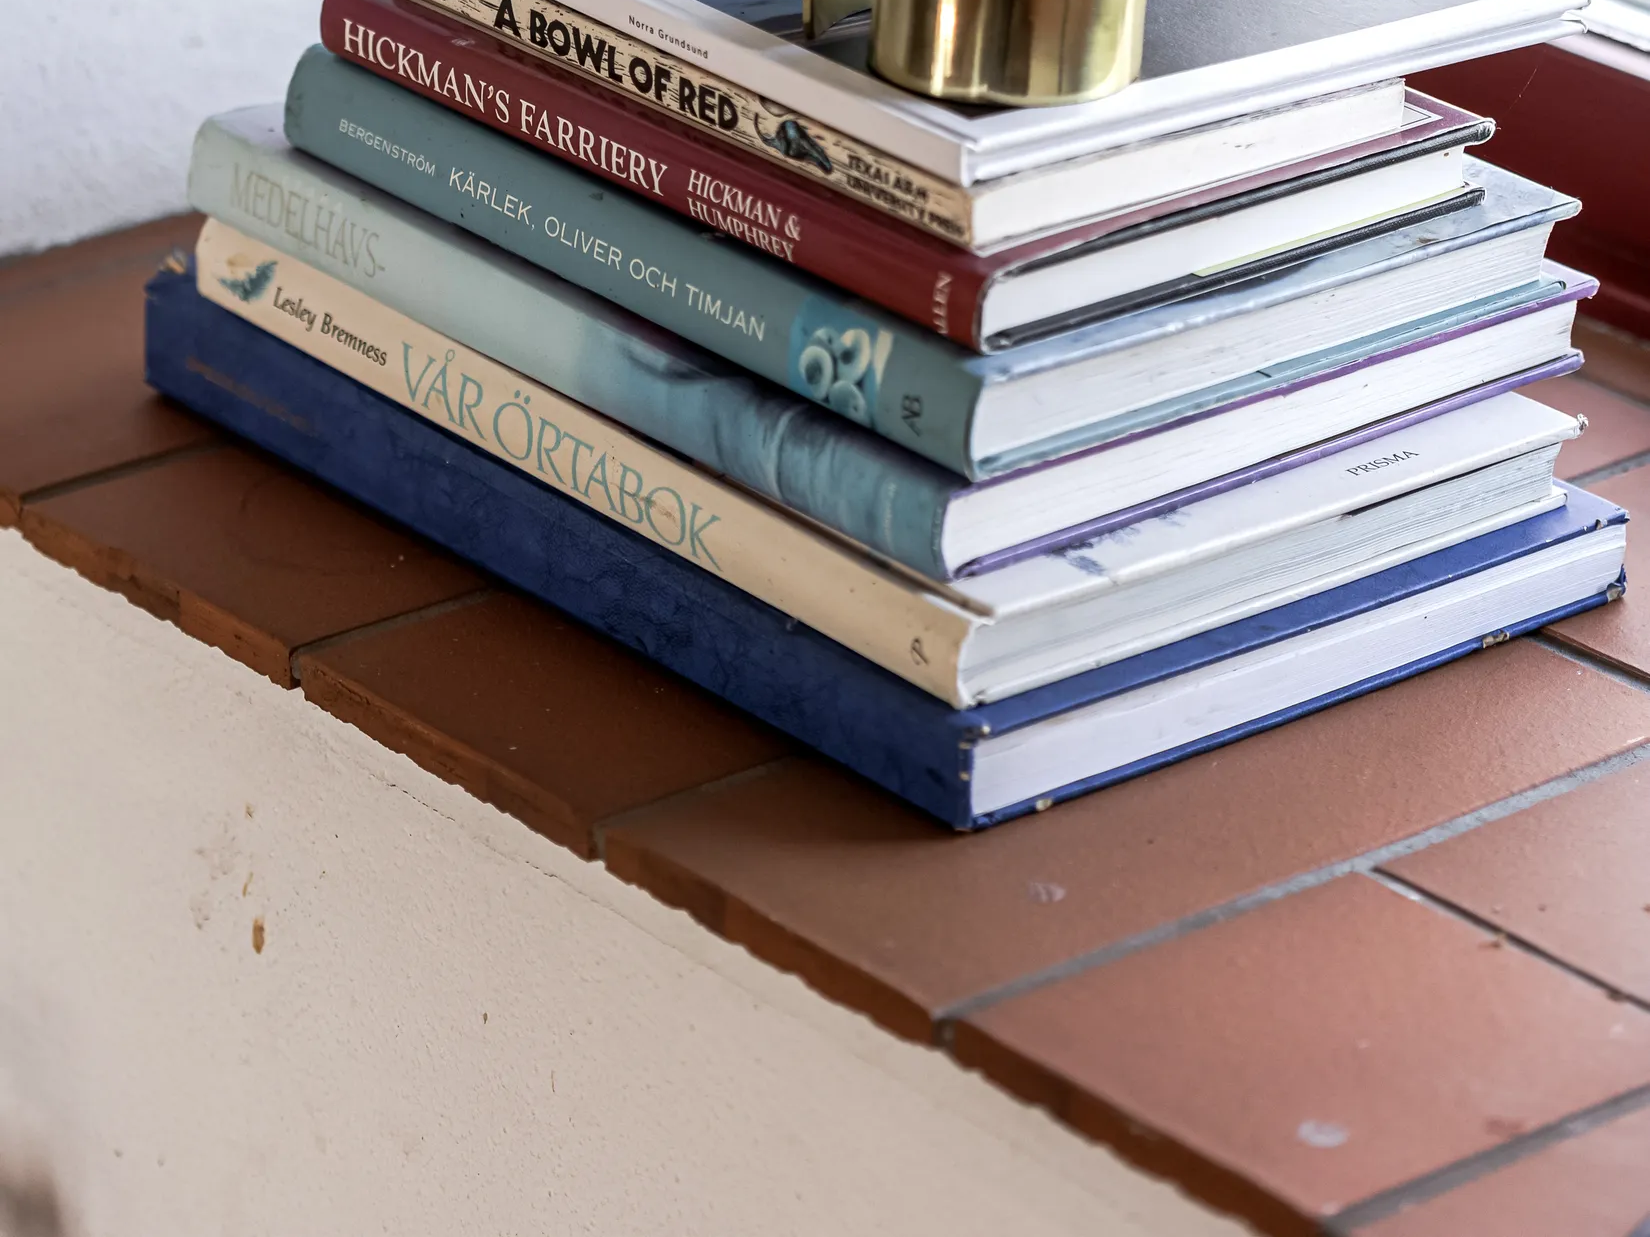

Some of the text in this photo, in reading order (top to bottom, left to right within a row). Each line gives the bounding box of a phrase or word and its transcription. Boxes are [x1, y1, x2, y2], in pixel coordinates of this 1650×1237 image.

[529, 8, 623, 83] BOWL
[629, 57, 671, 102] OF
[679, 75, 739, 131] RED
[628, 15, 709, 60] Norra Grundsund
[338, 118, 436, 177] BERGENSTRÖM
[343, 18, 668, 197] HICKMAN'S FARRIERY
[229, 162, 386, 278] MEDELHAVS-
[686, 196, 796, 263] HUMPHREY
[687, 168, 801, 241] HICKMAN &
[449, 166, 765, 341] KÄRLEK, OLIVER OCH TIMJAN
[273, 287, 388, 367] Lesley Bremness
[402, 341, 487, 442] VÅR
[493, 390, 723, 572] ÖRTABOK
[1345, 449, 1420, 476] PRISMA
